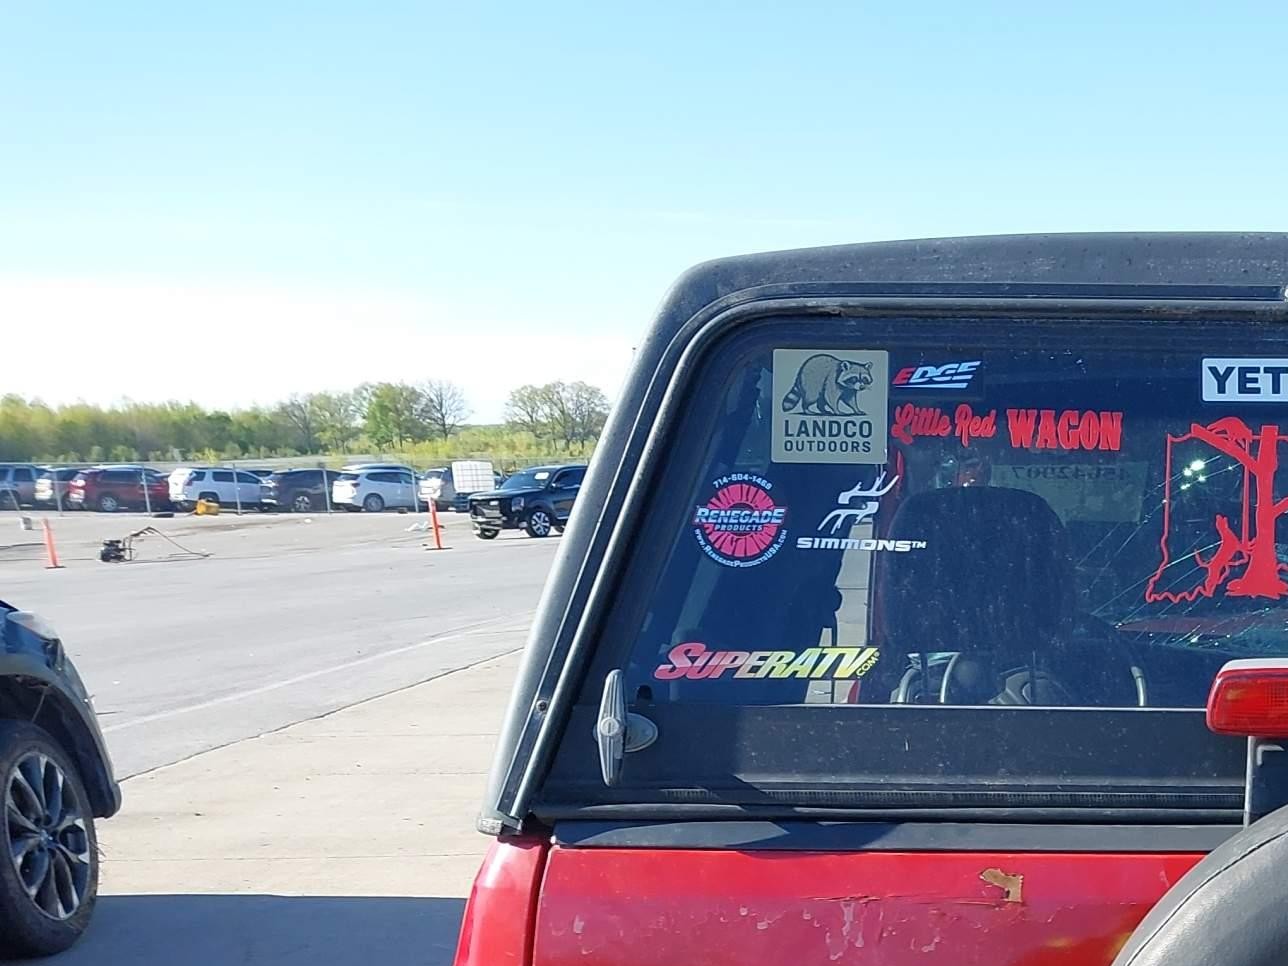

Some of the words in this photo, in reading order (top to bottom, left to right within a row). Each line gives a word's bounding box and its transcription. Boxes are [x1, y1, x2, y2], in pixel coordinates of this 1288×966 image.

[892, 361, 981, 385] EDGE
[784, 420, 873, 438] LANDCO
[891, 403, 952, 445] Little
[955, 404, 996, 447] Red
[1007, 409, 1123, 450] WAGON
[784, 440, 872, 452] OUTDOORS
[694, 507, 786, 523] RENEGADE
